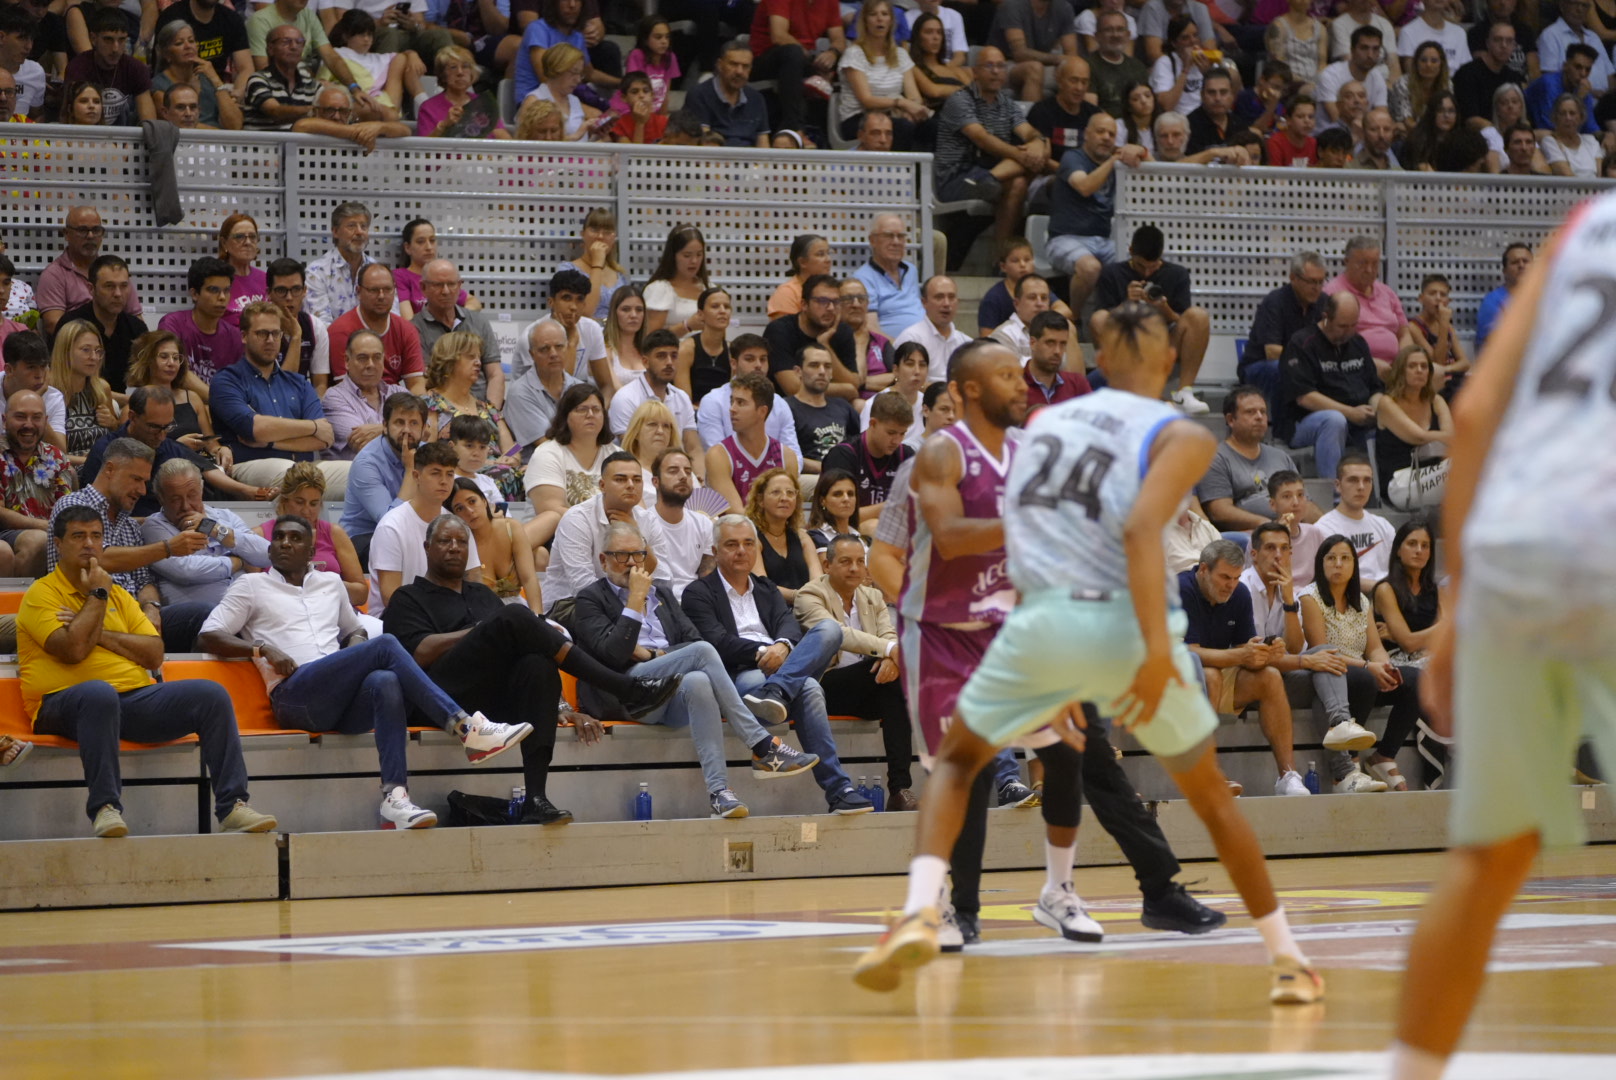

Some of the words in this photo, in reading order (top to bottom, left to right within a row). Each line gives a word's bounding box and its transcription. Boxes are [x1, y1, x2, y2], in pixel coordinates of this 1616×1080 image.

[1018, 433, 1116, 522] 24
[1421, 471, 1449, 494] HAPP
[870, 489, 885, 505] 15
[1350, 532, 1376, 549] NIKE
